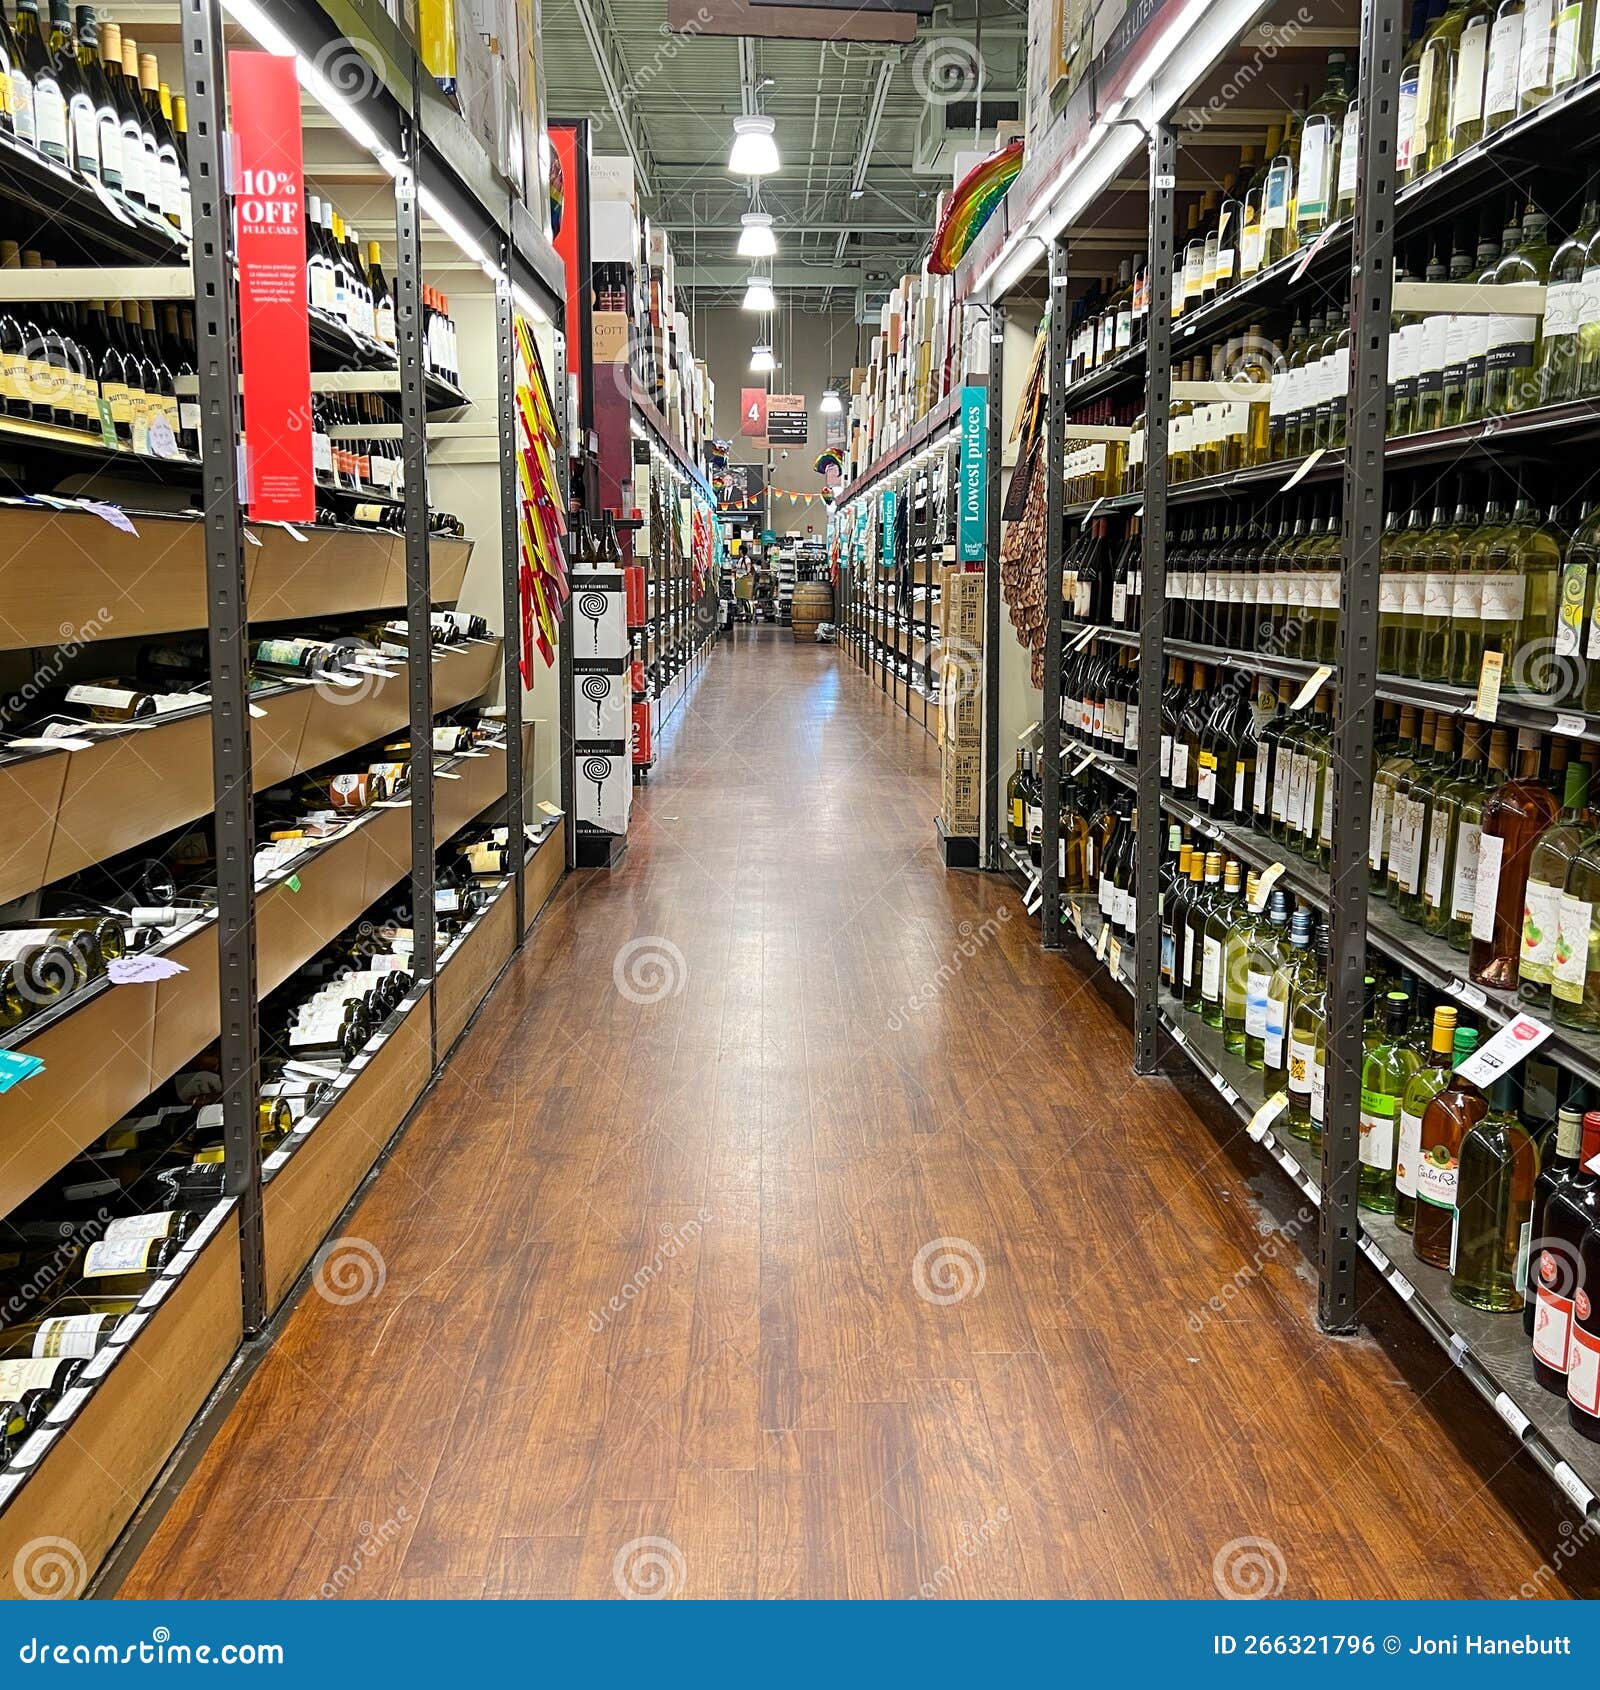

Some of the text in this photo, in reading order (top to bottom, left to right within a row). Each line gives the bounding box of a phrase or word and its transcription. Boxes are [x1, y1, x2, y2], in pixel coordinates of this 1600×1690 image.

[242, 169, 296, 196] 10%
[1160, 178, 1171, 187] 16
[242, 201, 298, 224] OFF
[242, 225, 298, 235] FULL CASES
[748, 402, 760, 421] 4
[964, 405, 983, 522] Lowest prices
